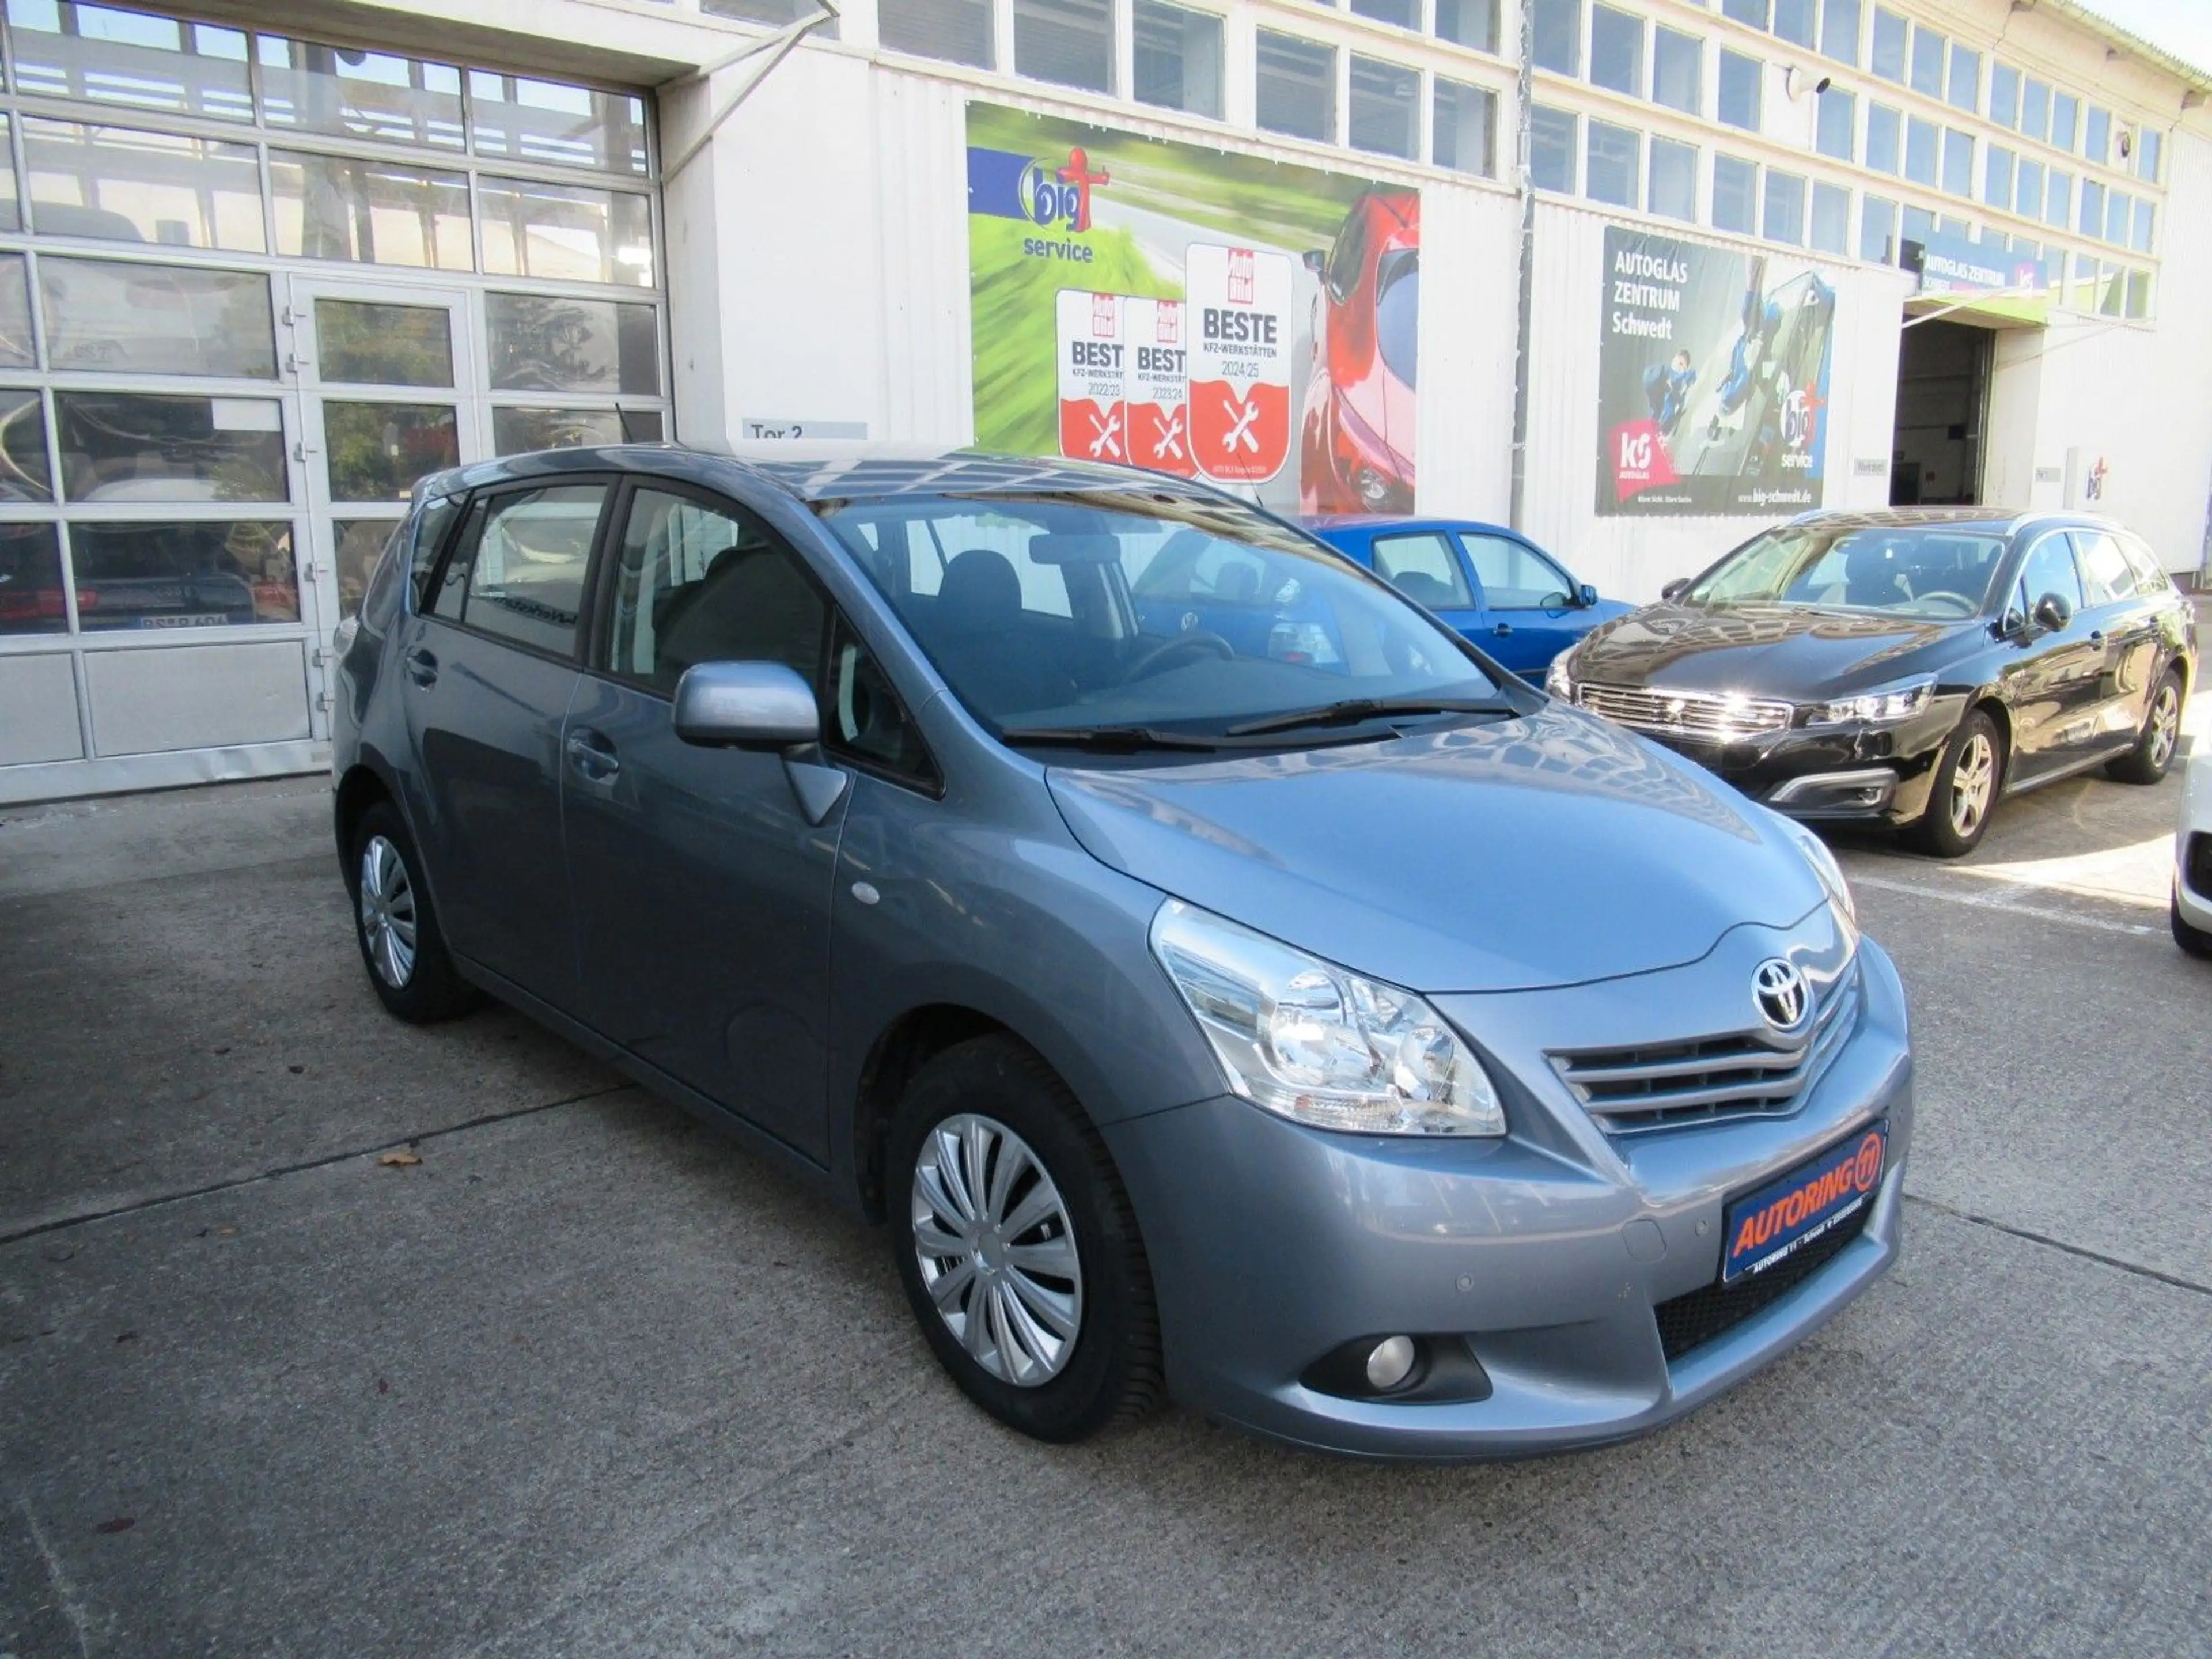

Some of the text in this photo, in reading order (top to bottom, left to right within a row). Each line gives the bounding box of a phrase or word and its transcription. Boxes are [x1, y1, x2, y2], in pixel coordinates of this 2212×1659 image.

[1024, 238, 1093, 263] service
[1615, 251, 1688, 284] AUTOGLAS
[1614, 281, 1680, 312] ZENTRUM
[1204, 308, 1277, 344] BESTE
[1613, 312, 1672, 340] Schwedt
[751, 424, 803, 439] Tor 2
[1733, 1157, 1854, 1258] AUTORING
